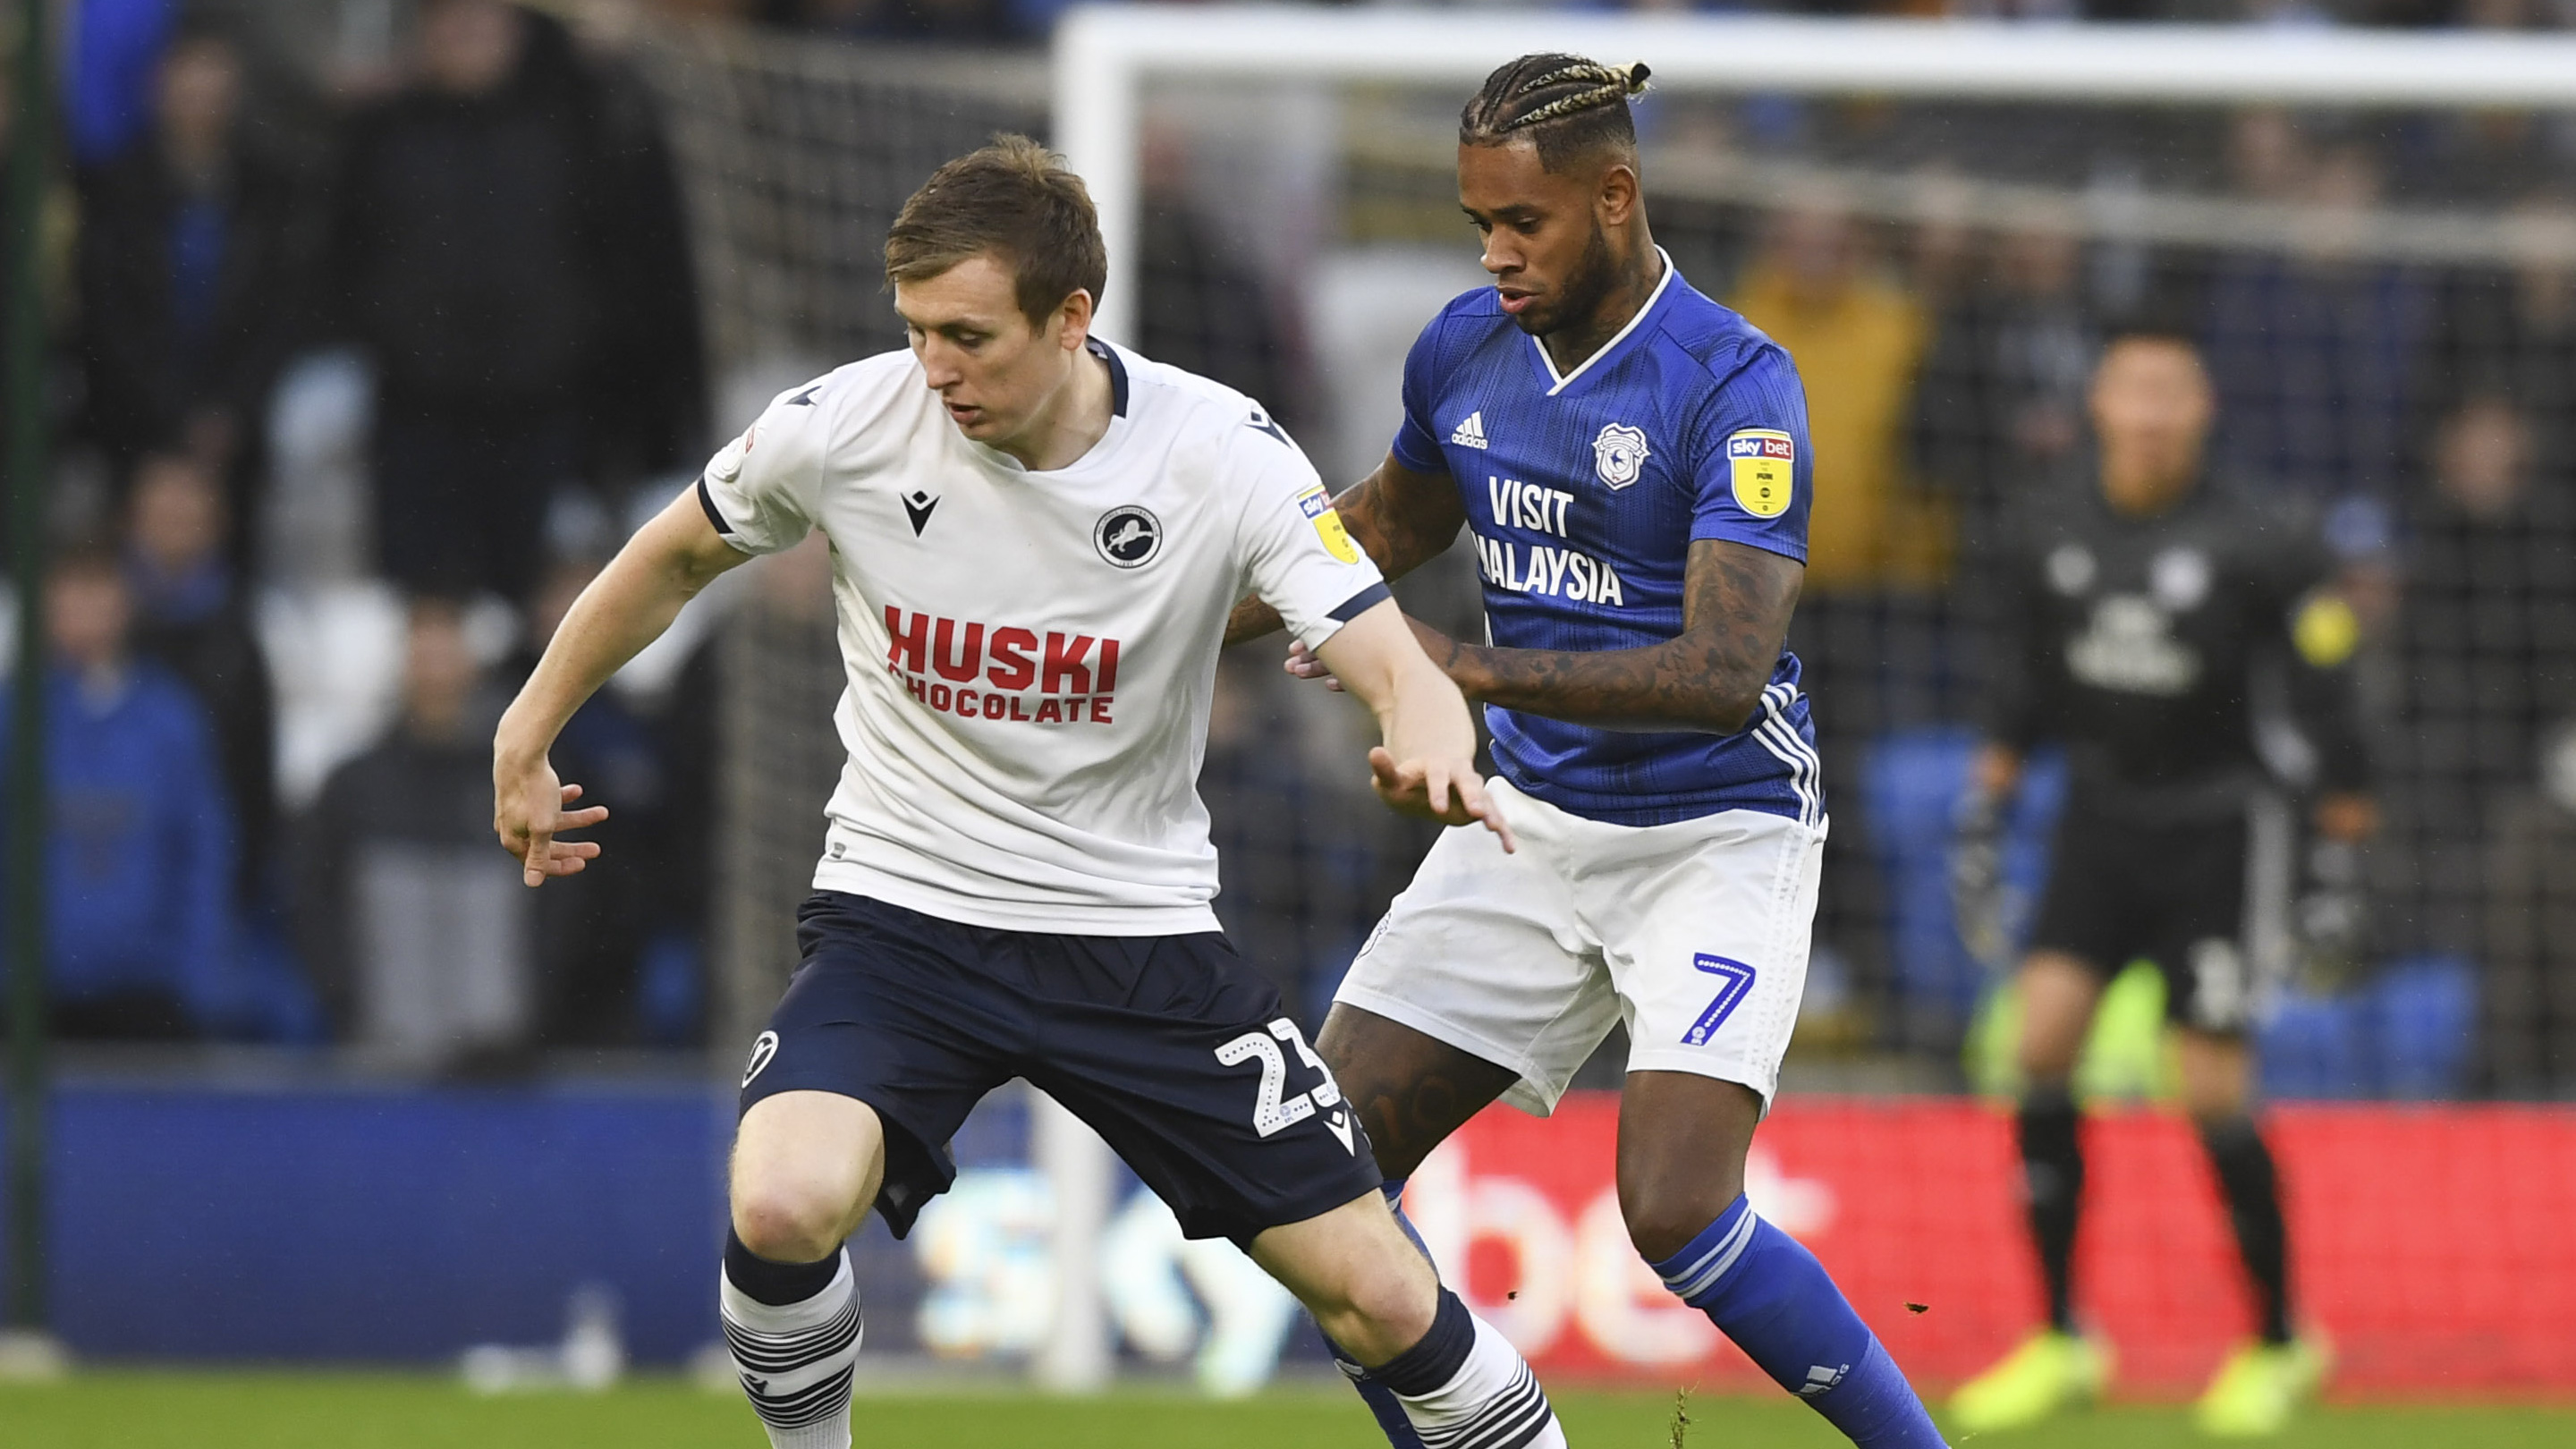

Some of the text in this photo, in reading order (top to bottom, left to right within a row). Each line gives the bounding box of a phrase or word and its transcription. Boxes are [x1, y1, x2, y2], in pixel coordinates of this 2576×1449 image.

[1452, 433, 1488, 450] adidas
[1733, 439, 1790, 456] sky bet
[1488, 475, 1574, 538] VISIT
[1470, 530, 1623, 606] MALAYSIA
[884, 604, 1120, 694] HUSKI
[1681, 952, 1756, 1046] 7
[1214, 1017, 1341, 1138] 23
